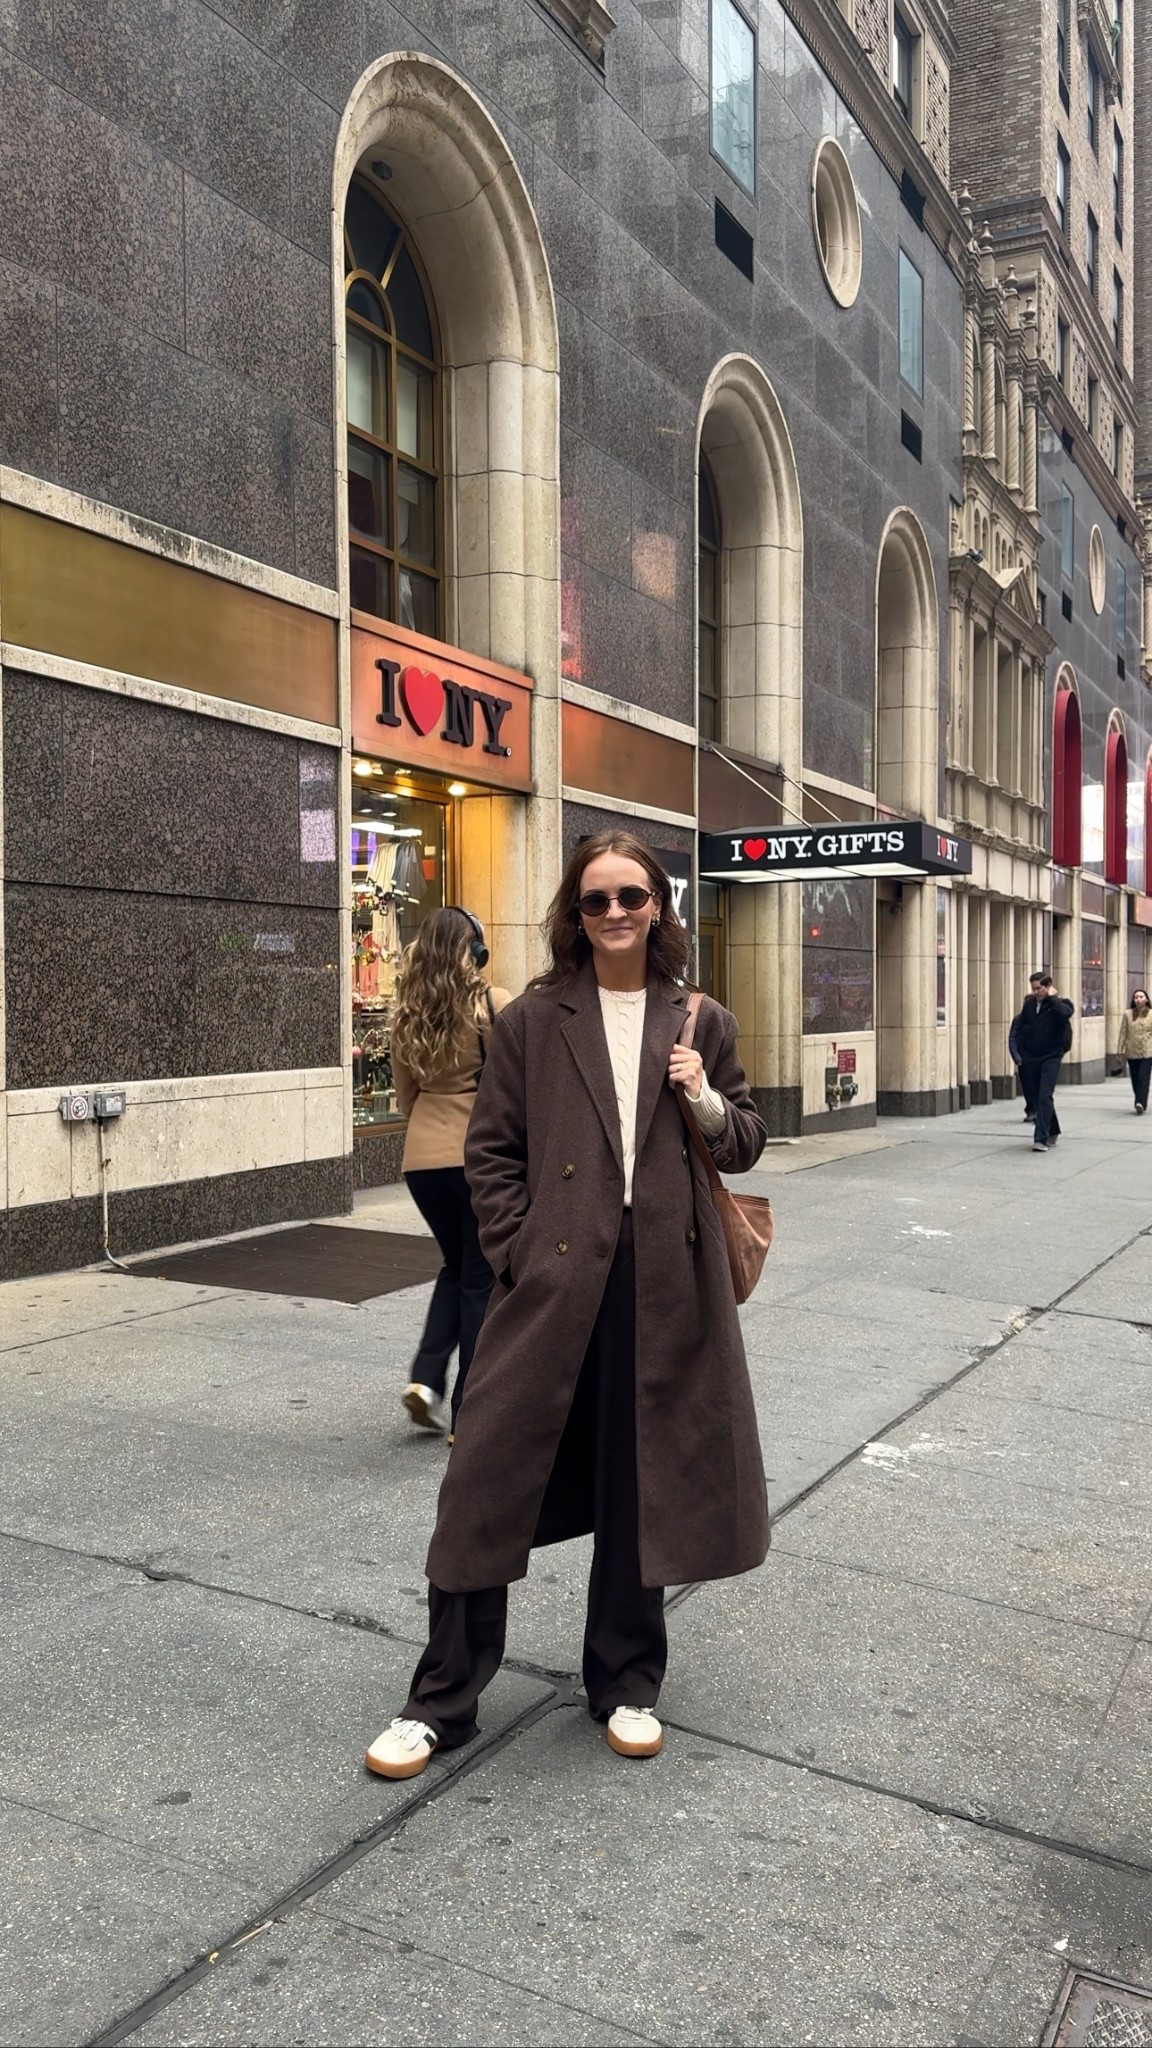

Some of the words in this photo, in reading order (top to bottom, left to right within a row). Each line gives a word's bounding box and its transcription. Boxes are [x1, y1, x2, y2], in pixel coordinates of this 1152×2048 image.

[375, 659, 401, 727] I
[731, 840, 742, 861] I
[817, 831, 904, 856] GIFTS
[946, 839, 958, 862] NY
